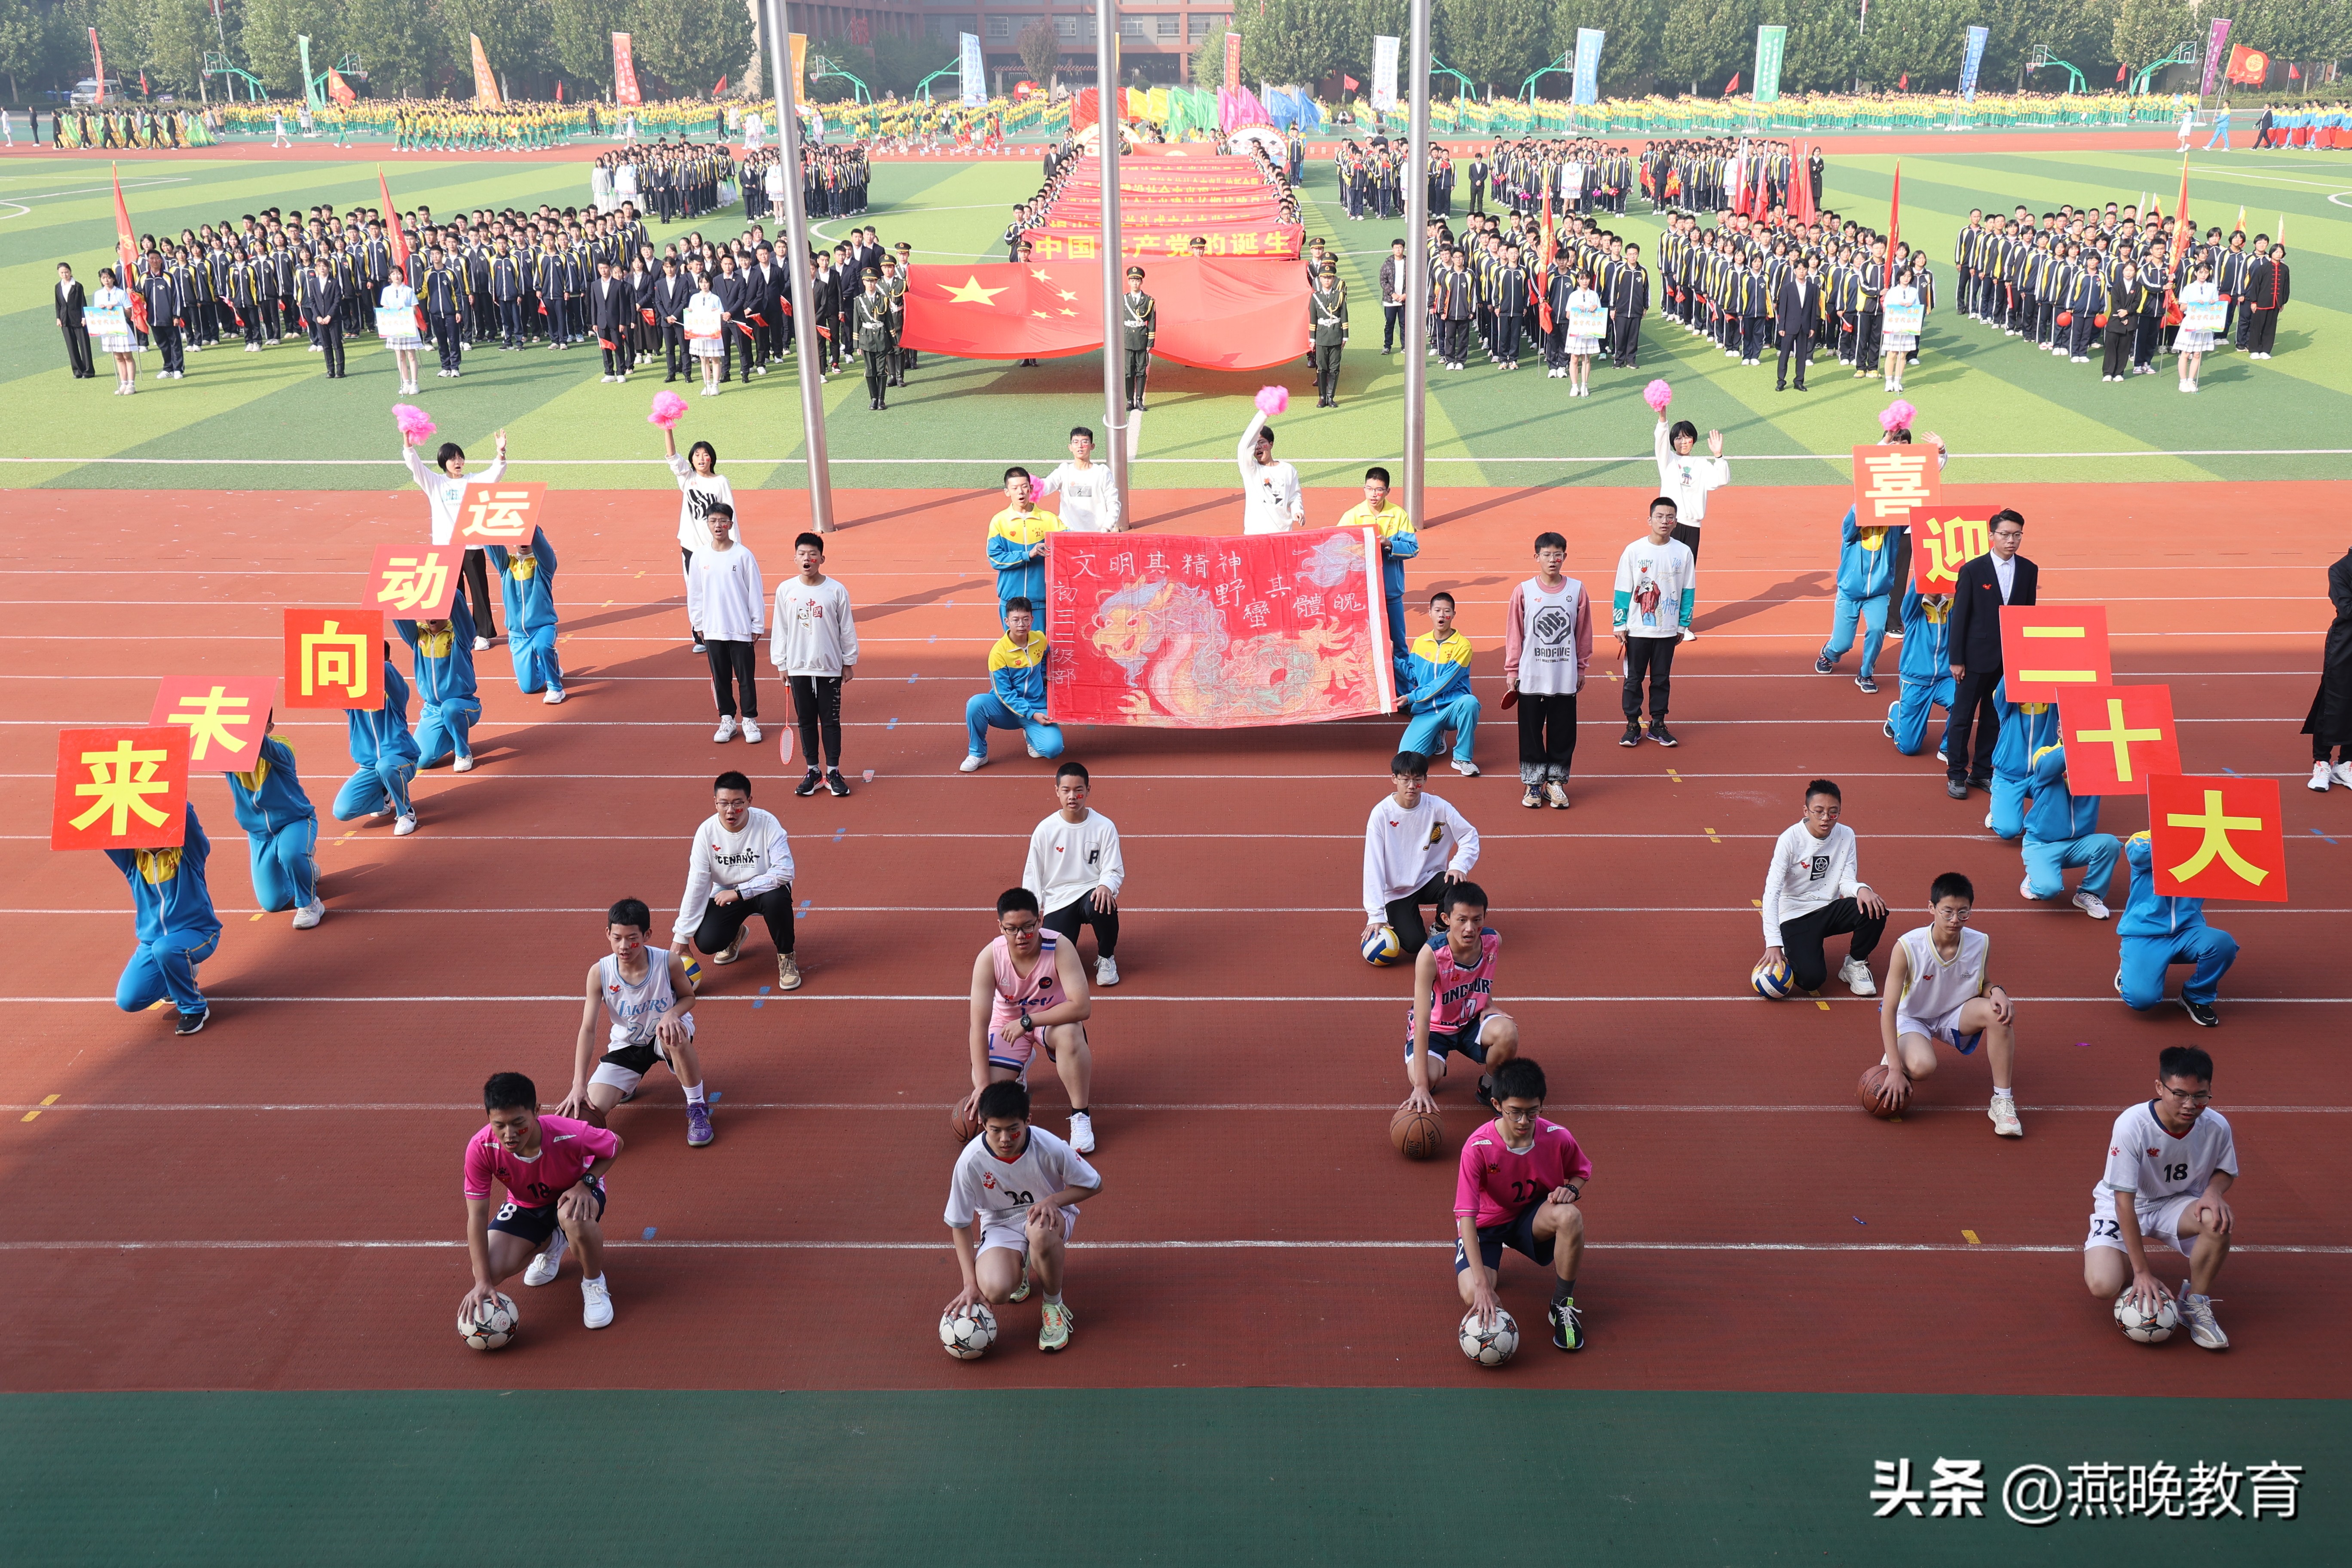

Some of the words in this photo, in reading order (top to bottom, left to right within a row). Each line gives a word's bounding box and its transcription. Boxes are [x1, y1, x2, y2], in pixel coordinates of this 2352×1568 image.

[1864, 453, 1930, 518] 喜
[462, 490, 530, 537] 运
[1071, 549, 1241, 579] 文明其精神
[1922, 516, 1989, 583] 迎
[377, 552, 448, 611] 动
[806, 598, 823, 619] 中國
[1051, 580, 1079, 689] 初三二级部
[300, 619, 368, 699] 向
[1534, 647, 1571, 657] BADFIVE
[2018, 626, 2097, 683] 二
[167, 685, 251, 761] 未
[2076, 698, 2162, 782] 十
[68, 740, 171, 836] 来
[2166, 789, 2270, 887] 大
[619, 997, 671, 1018] LAKERS
[1460, 998, 1477, 1019] 17
[627, 1017, 661, 1046] 24
[2164, 1163, 2188, 1183] 18
[527, 1182, 552, 1200] 18
[1004, 1190, 1034, 1206] 20
[1511, 1179, 1537, 1203] 22
[496, 1202, 517, 1221] 8
[2092, 1219, 2120, 1240] 22
